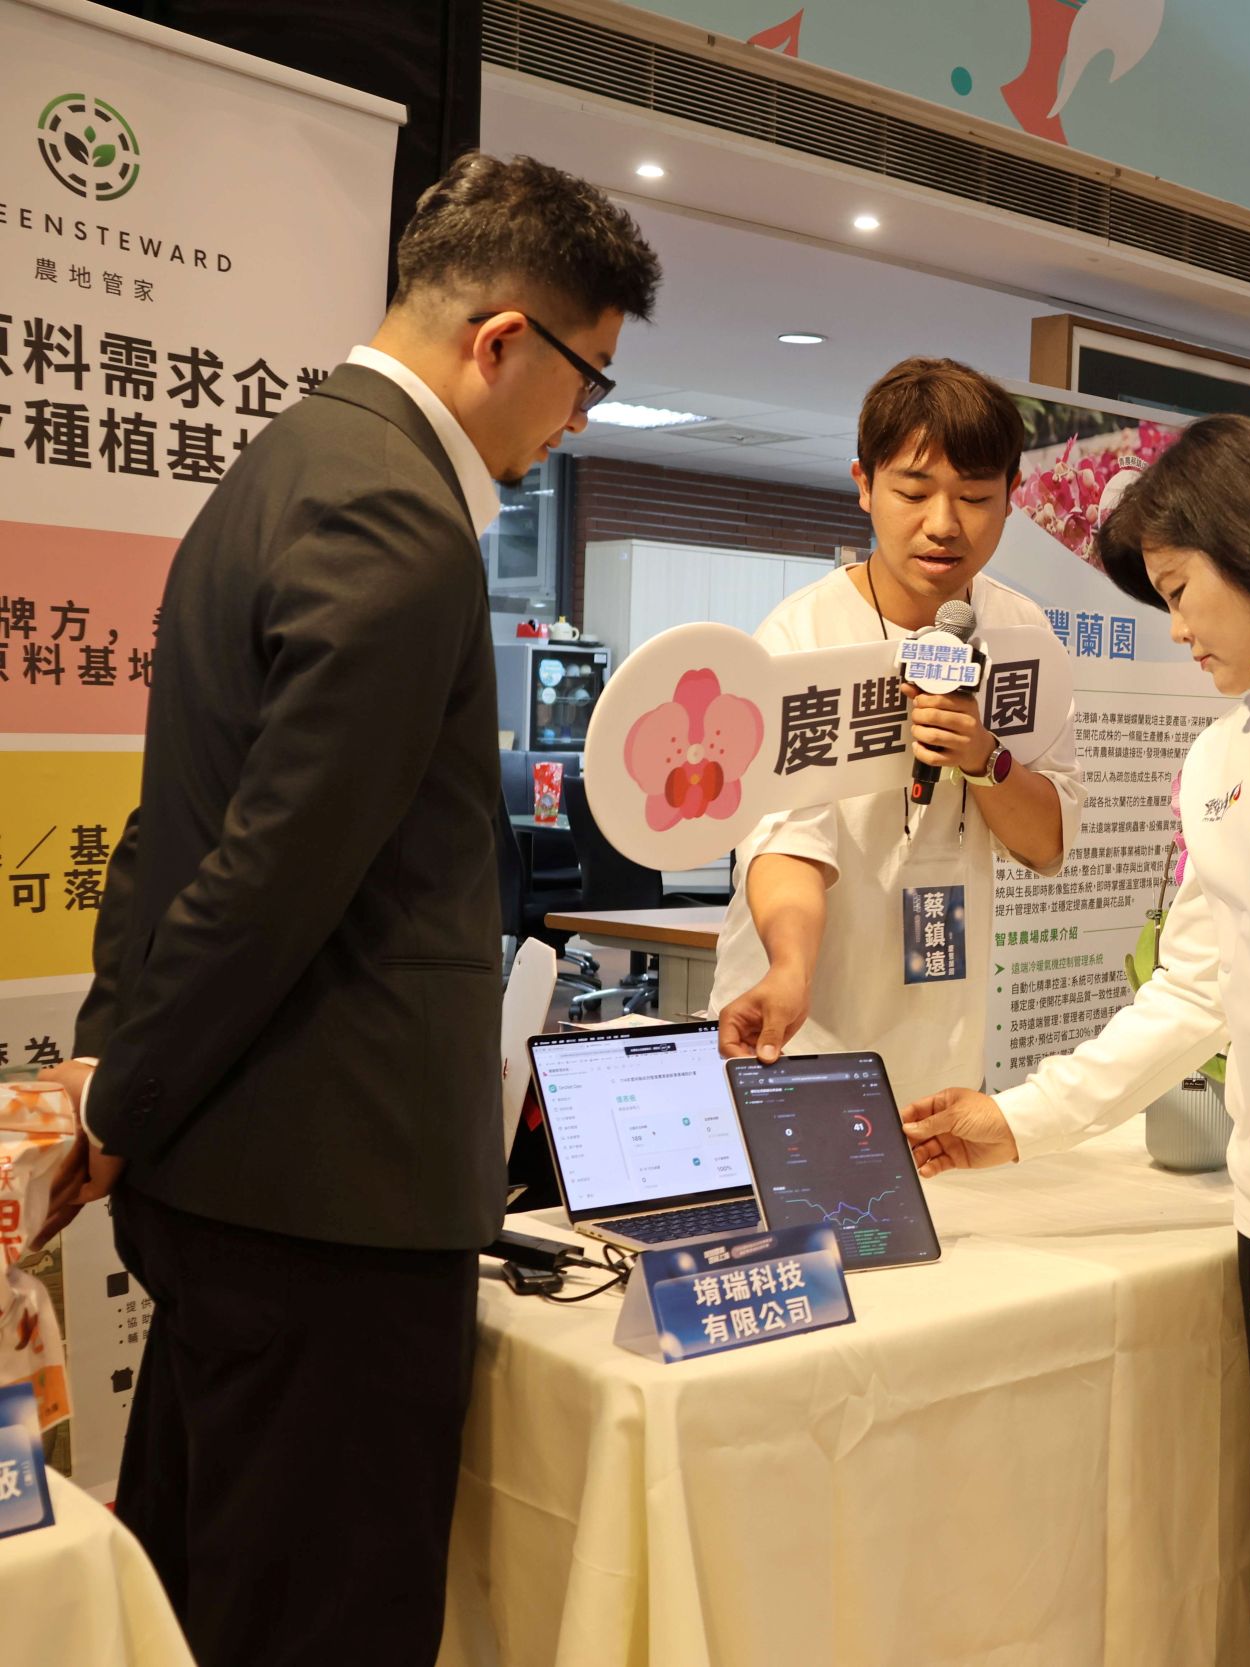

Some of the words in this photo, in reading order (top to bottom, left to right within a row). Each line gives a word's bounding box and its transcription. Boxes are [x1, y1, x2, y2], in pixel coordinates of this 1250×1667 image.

[34, 257, 155, 302] 農地管家
[0, 313, 330, 419] 料需求企
[0, 397, 248, 485] 種植基
[0, 596, 163, 645] 牌方，
[0, 642, 155, 688] 料基地
[901, 642, 968, 663] 智慧農業
[908, 662, 976, 682] 雲林上場
[774, 659, 1040, 776] 慶豐園
[1082, 770, 1172, 784] 常因人為疏忽造成生長不均
[924, 891, 946, 977] 蔡鎮遠
[995, 926, 1078, 947] 智慧農場成果介紹
[853, 1123, 865, 1132] 41
[693, 1260, 806, 1307] 堉瑞科技
[702, 1296, 813, 1345] 有限公司
